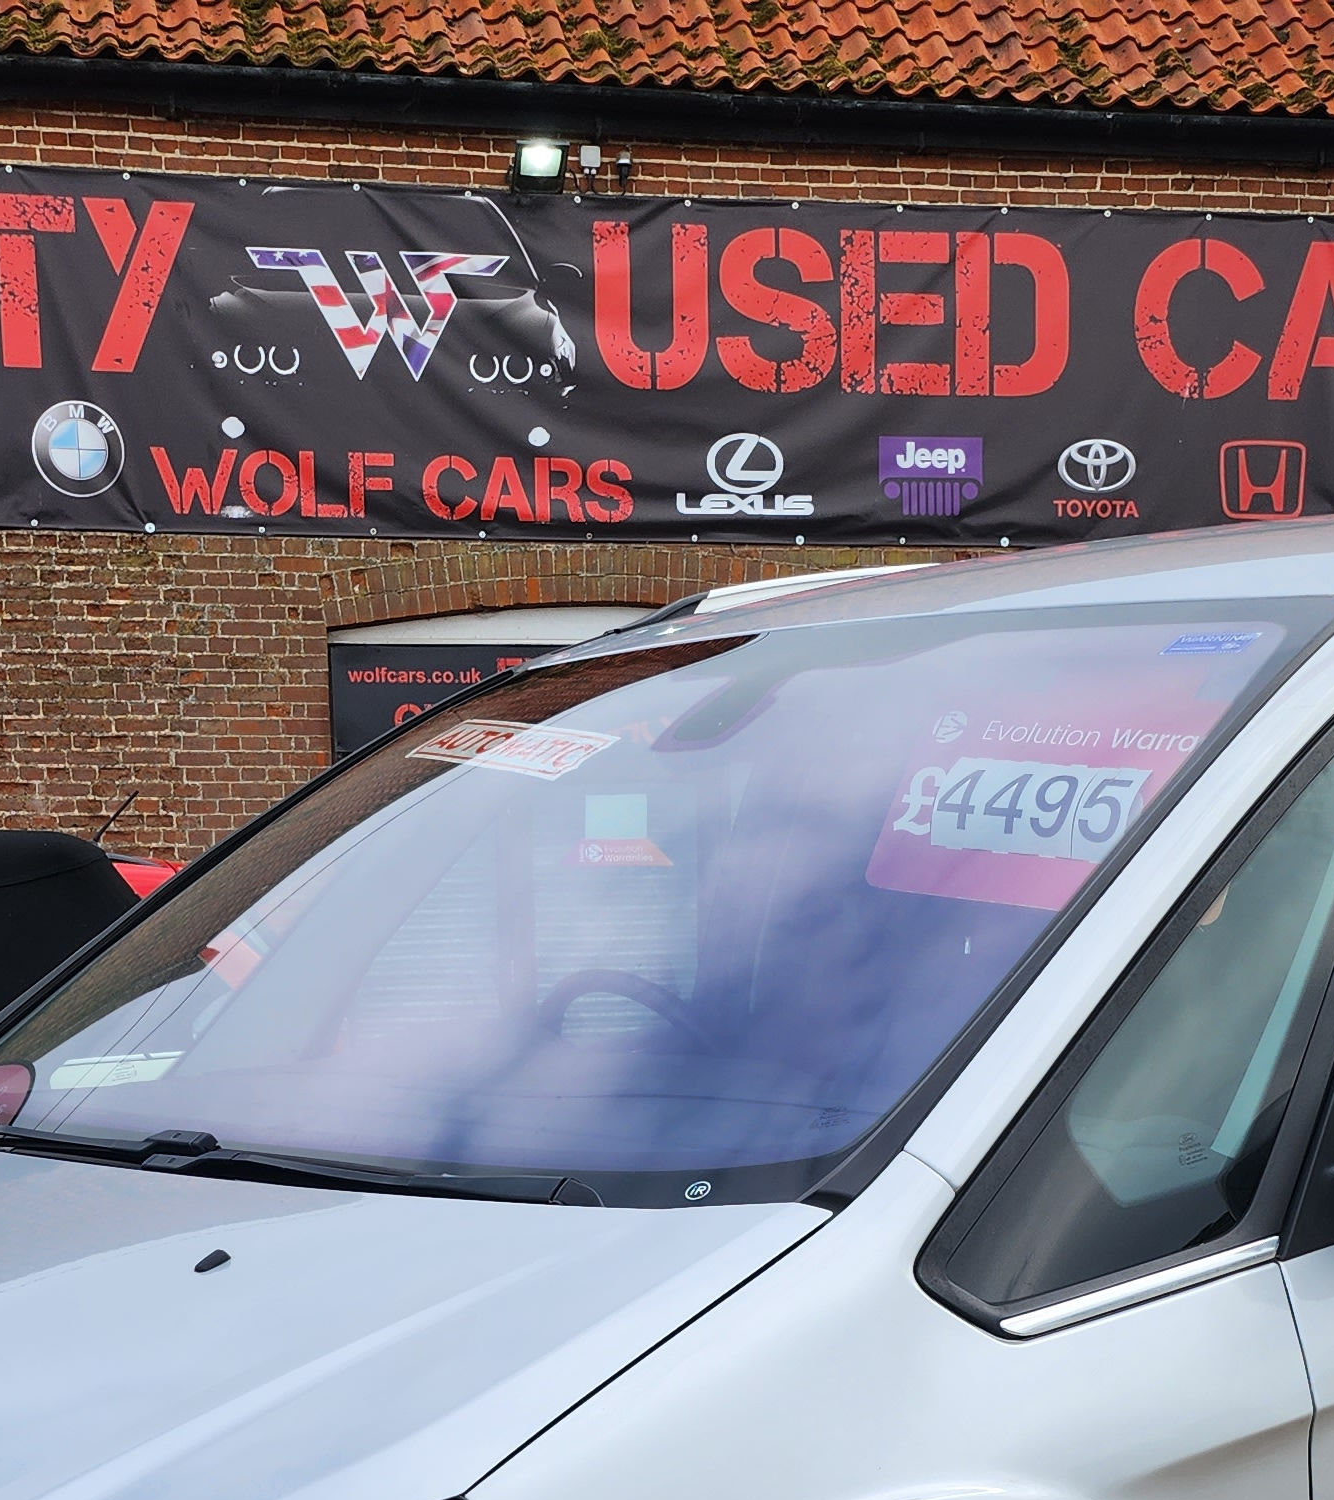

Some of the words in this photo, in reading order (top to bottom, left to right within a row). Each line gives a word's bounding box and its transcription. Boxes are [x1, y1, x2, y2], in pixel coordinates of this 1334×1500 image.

[592, 220, 1071, 397] USED
[41, 403, 116, 437] BMW
[895, 441, 968, 474] Jeep
[149, 445, 395, 518] WOLF
[422, 455, 634, 524] CARS
[675, 493, 815, 516] LEXUS
[1053, 499, 1139, 519] TOYOTA
[348, 666, 482, 685] wolfcars.co.uk
[429, 729, 594, 769] AUTOMATIC
[982, 720, 1101, 748] Evolution
[1111, 728, 1201, 754] Warra
